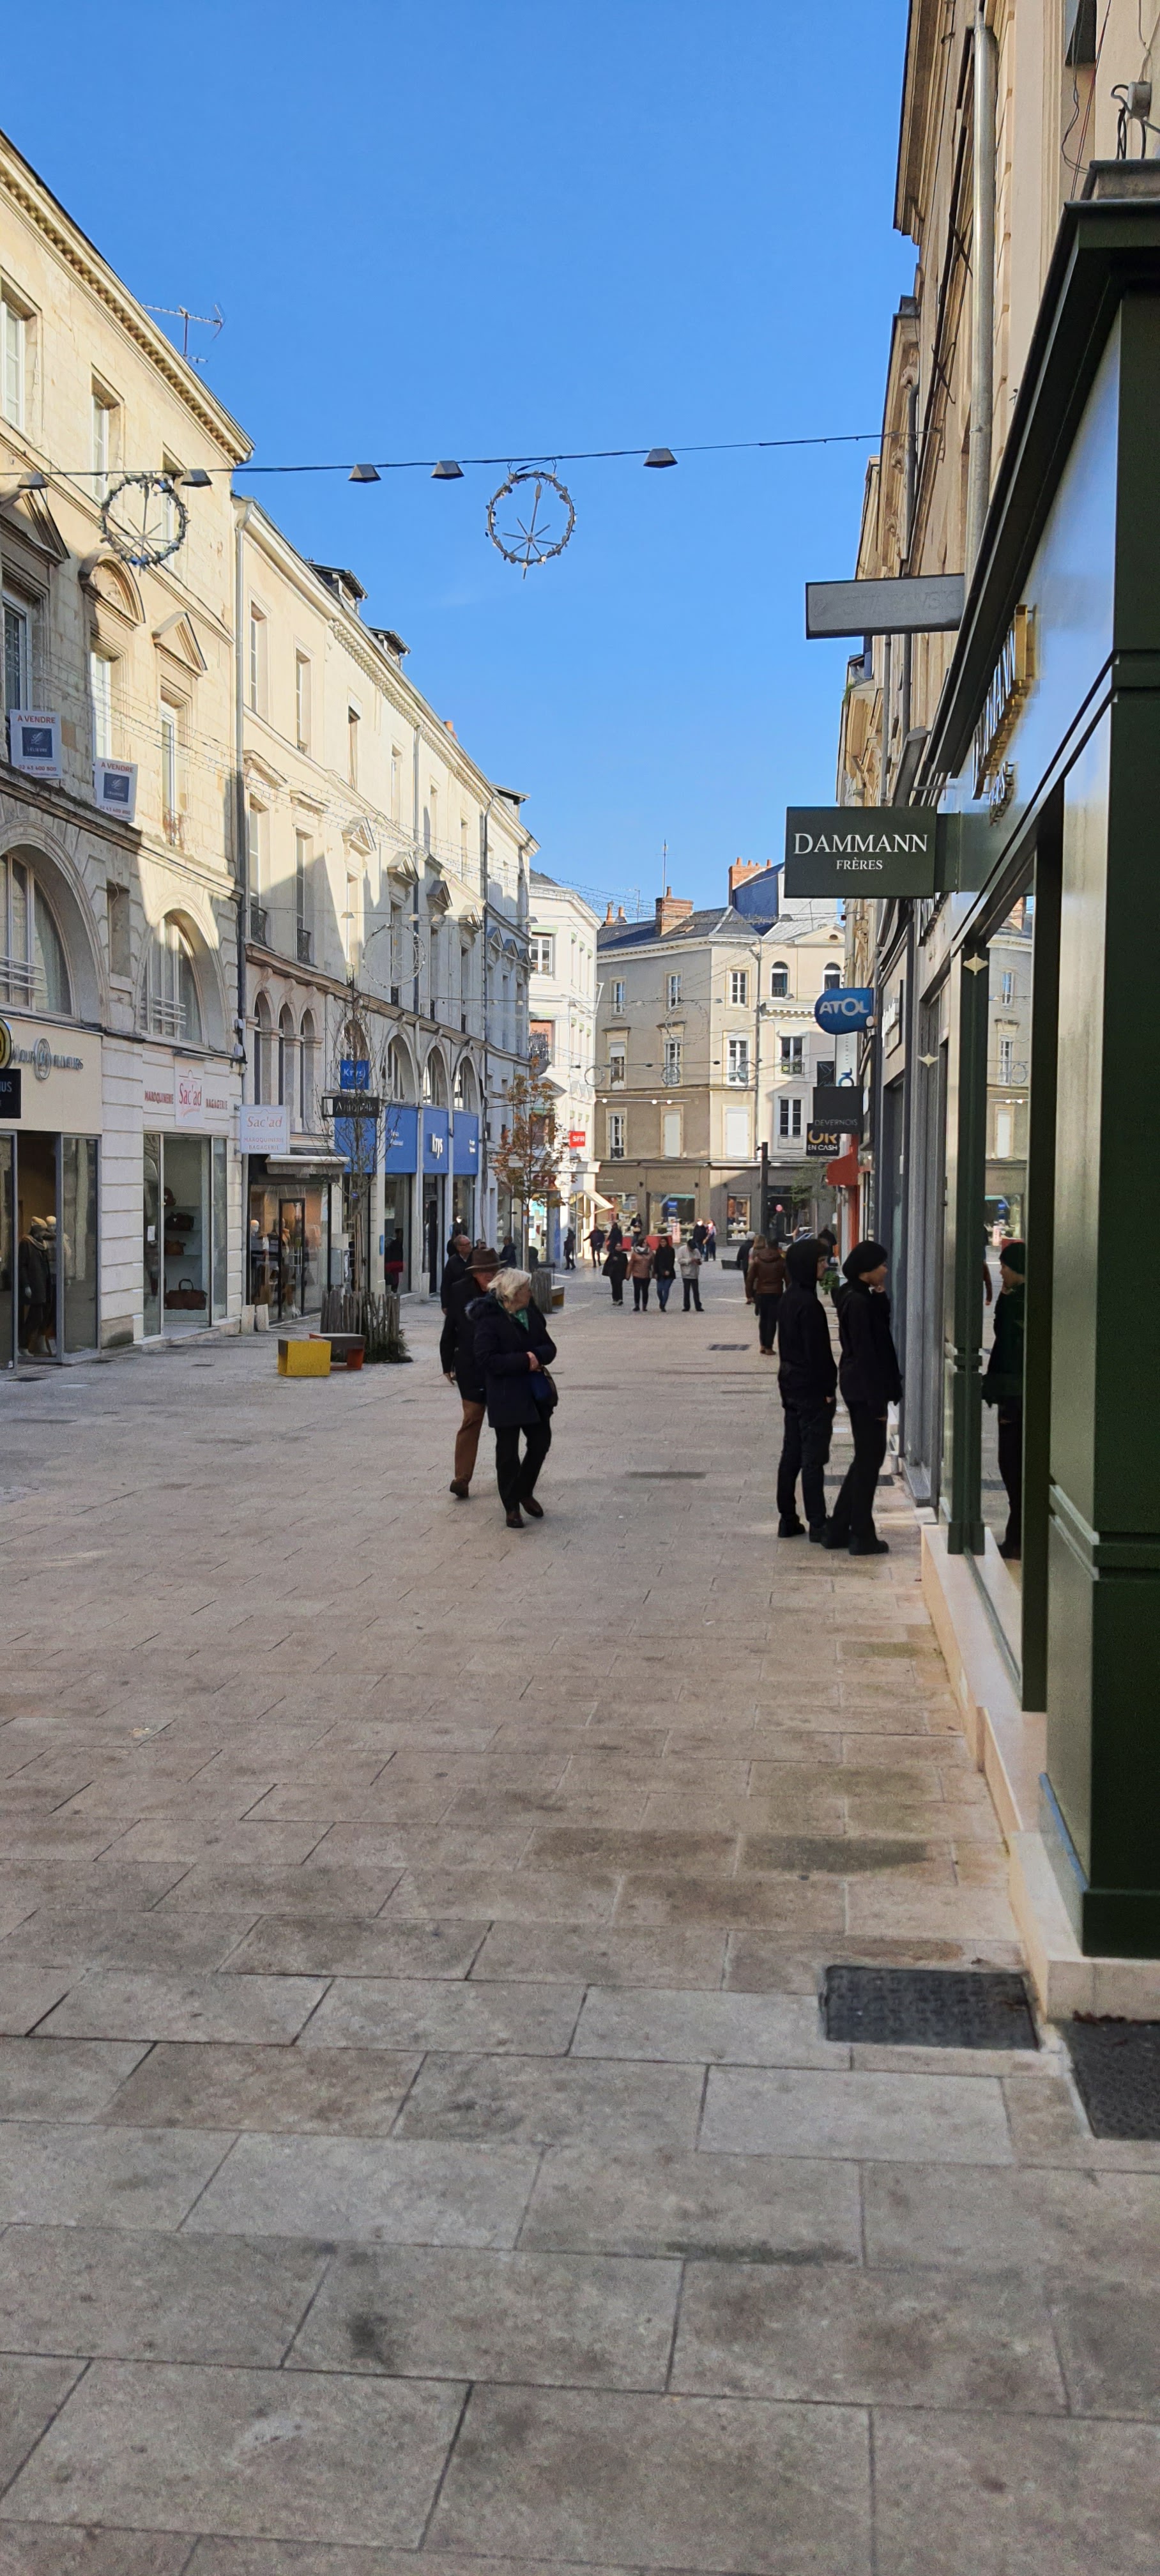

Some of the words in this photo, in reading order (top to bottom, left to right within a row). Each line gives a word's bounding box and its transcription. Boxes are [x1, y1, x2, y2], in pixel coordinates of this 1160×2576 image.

[24, 716, 56, 724] VENDRE
[107, 763, 134, 773] VENDRE
[793, 833, 927, 854] DAMMANN
[836, 857, 883, 870] FRÈRES
[819, 997, 869, 1016] ATOL
[179, 1083, 202, 1106] Sac'ad
[247, 1116, 283, 1128] Sac'ad
[808, 1129, 837, 1144] OR
[432, 1133, 443, 1160] Krys
